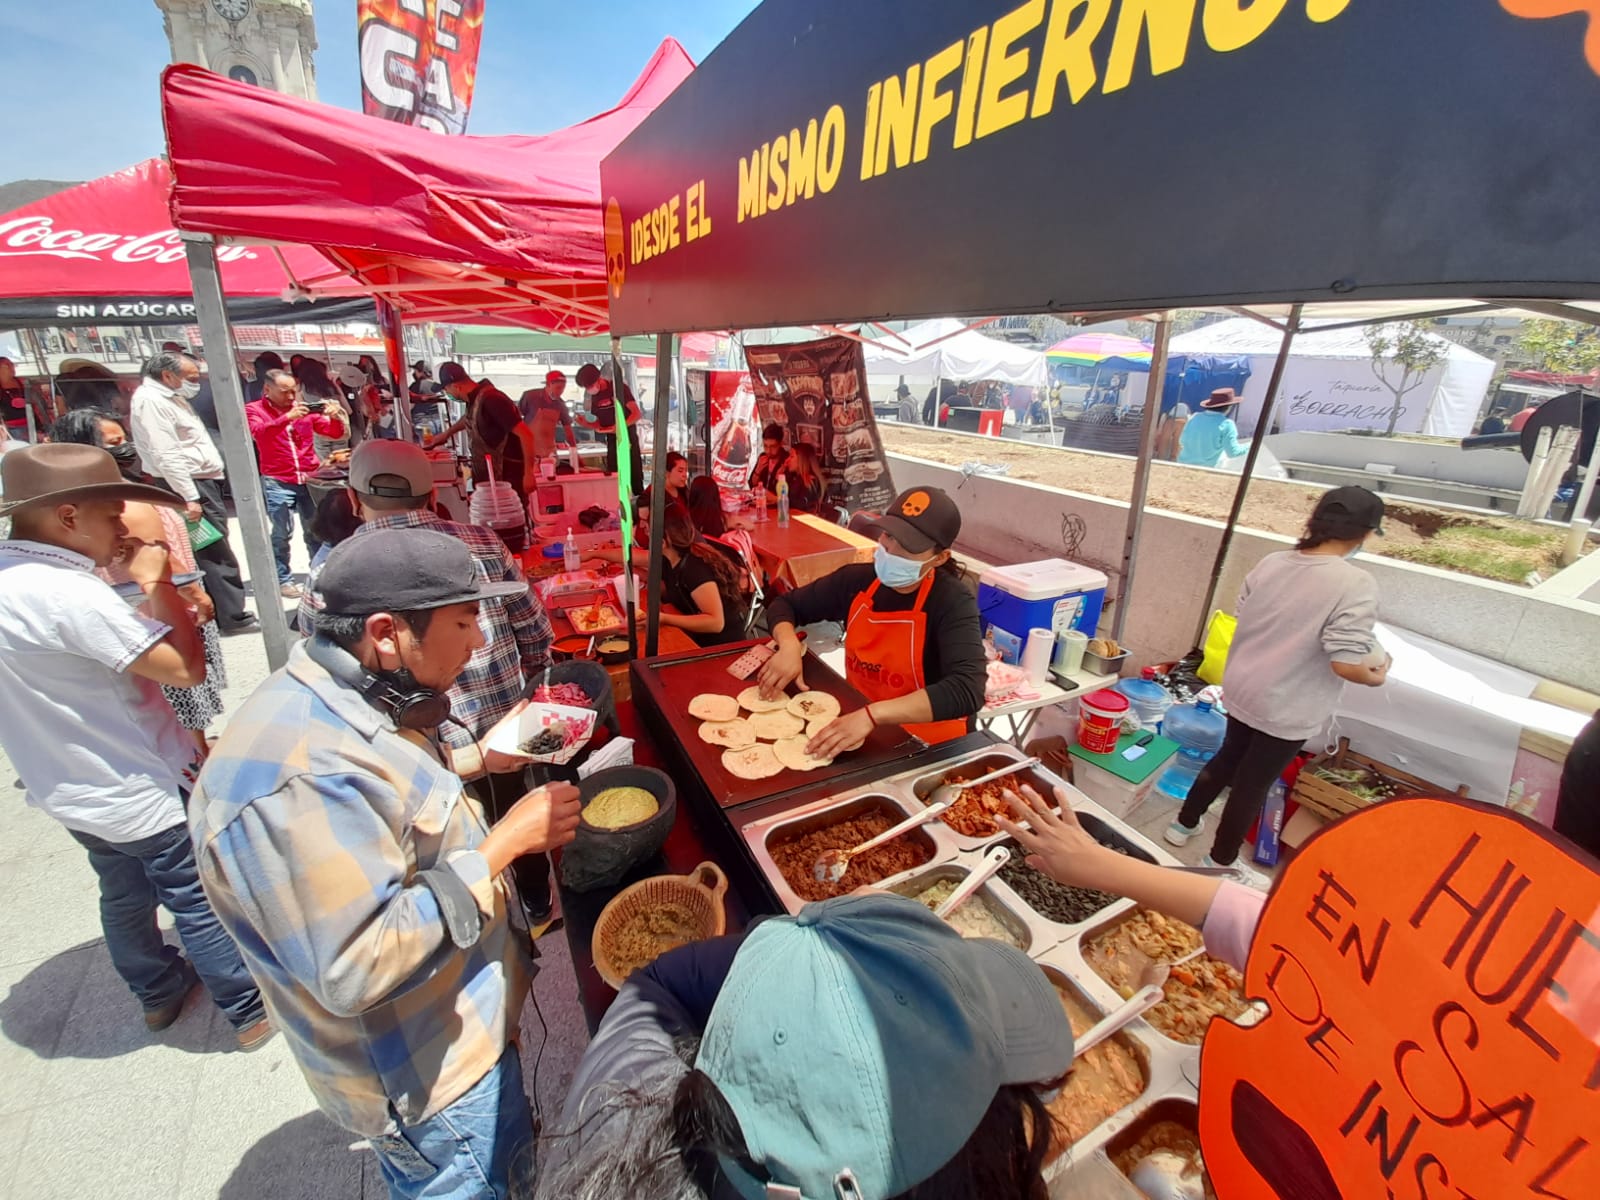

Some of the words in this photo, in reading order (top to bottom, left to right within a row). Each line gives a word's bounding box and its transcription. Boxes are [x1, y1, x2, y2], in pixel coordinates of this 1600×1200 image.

[686, 179, 712, 243] EL
[737, 104, 846, 223] MISMO
[860, 0, 1352, 181] INFIERN
[0, 216, 249, 263] oca-Coa
[57, 305, 95, 317] SIN
[103, 301, 196, 317] AZÚCAR
[1289, 398, 1407, 419] BORRACHO
[1306, 869, 1392, 985] EN
[1409, 831, 1600, 1090] HUE
[1265, 943, 1354, 1073] DE
[1339, 1080, 1476, 1200] INS
